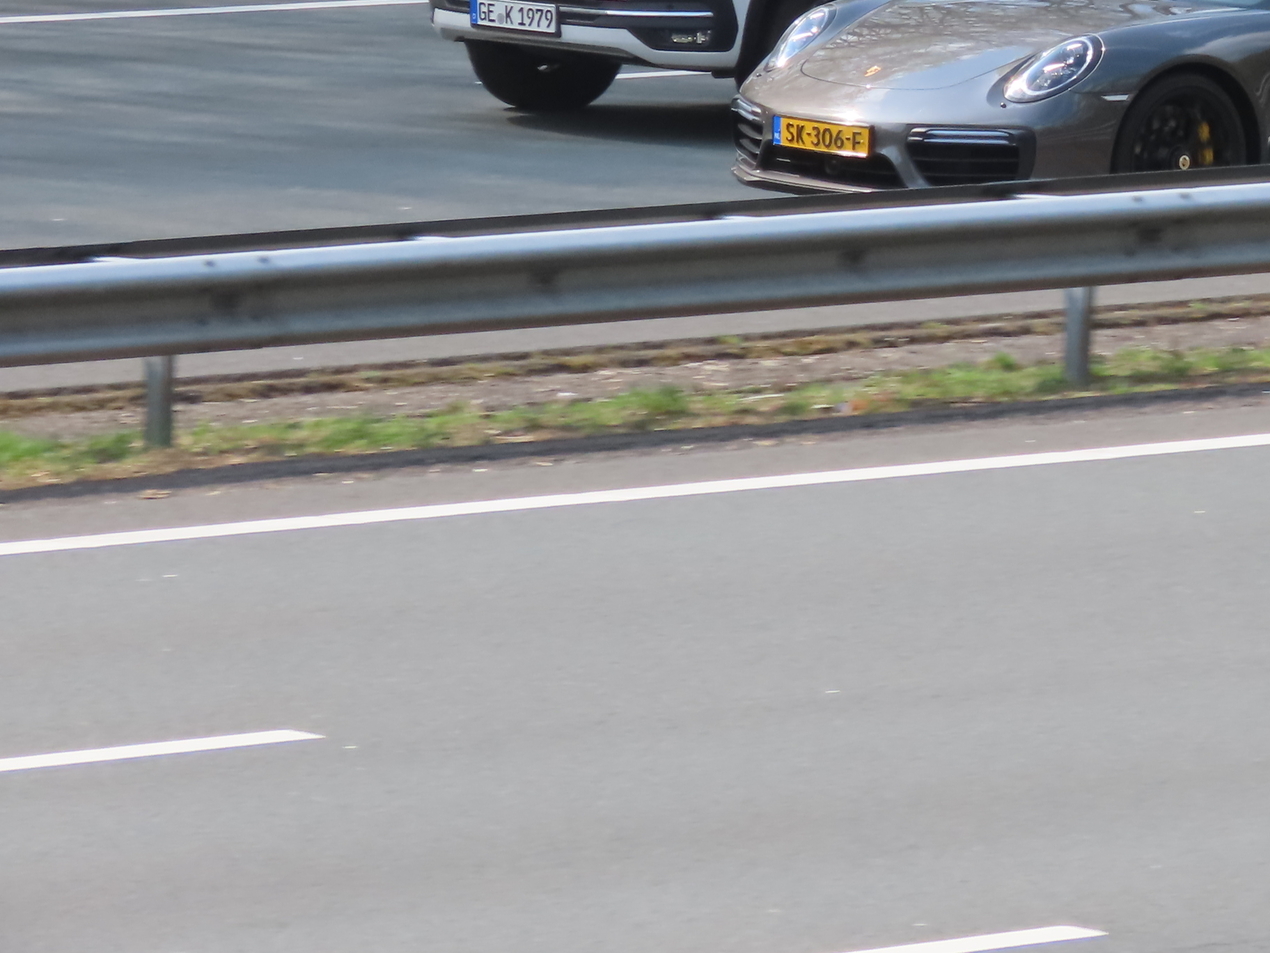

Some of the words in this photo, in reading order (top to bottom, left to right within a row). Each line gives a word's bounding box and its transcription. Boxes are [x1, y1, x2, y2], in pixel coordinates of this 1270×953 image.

[478, 2, 496, 23] GE
[504, 5, 514, 25] K
[517, 6, 554, 29] 1979
[786, 122, 862, 150] SK-306-F
